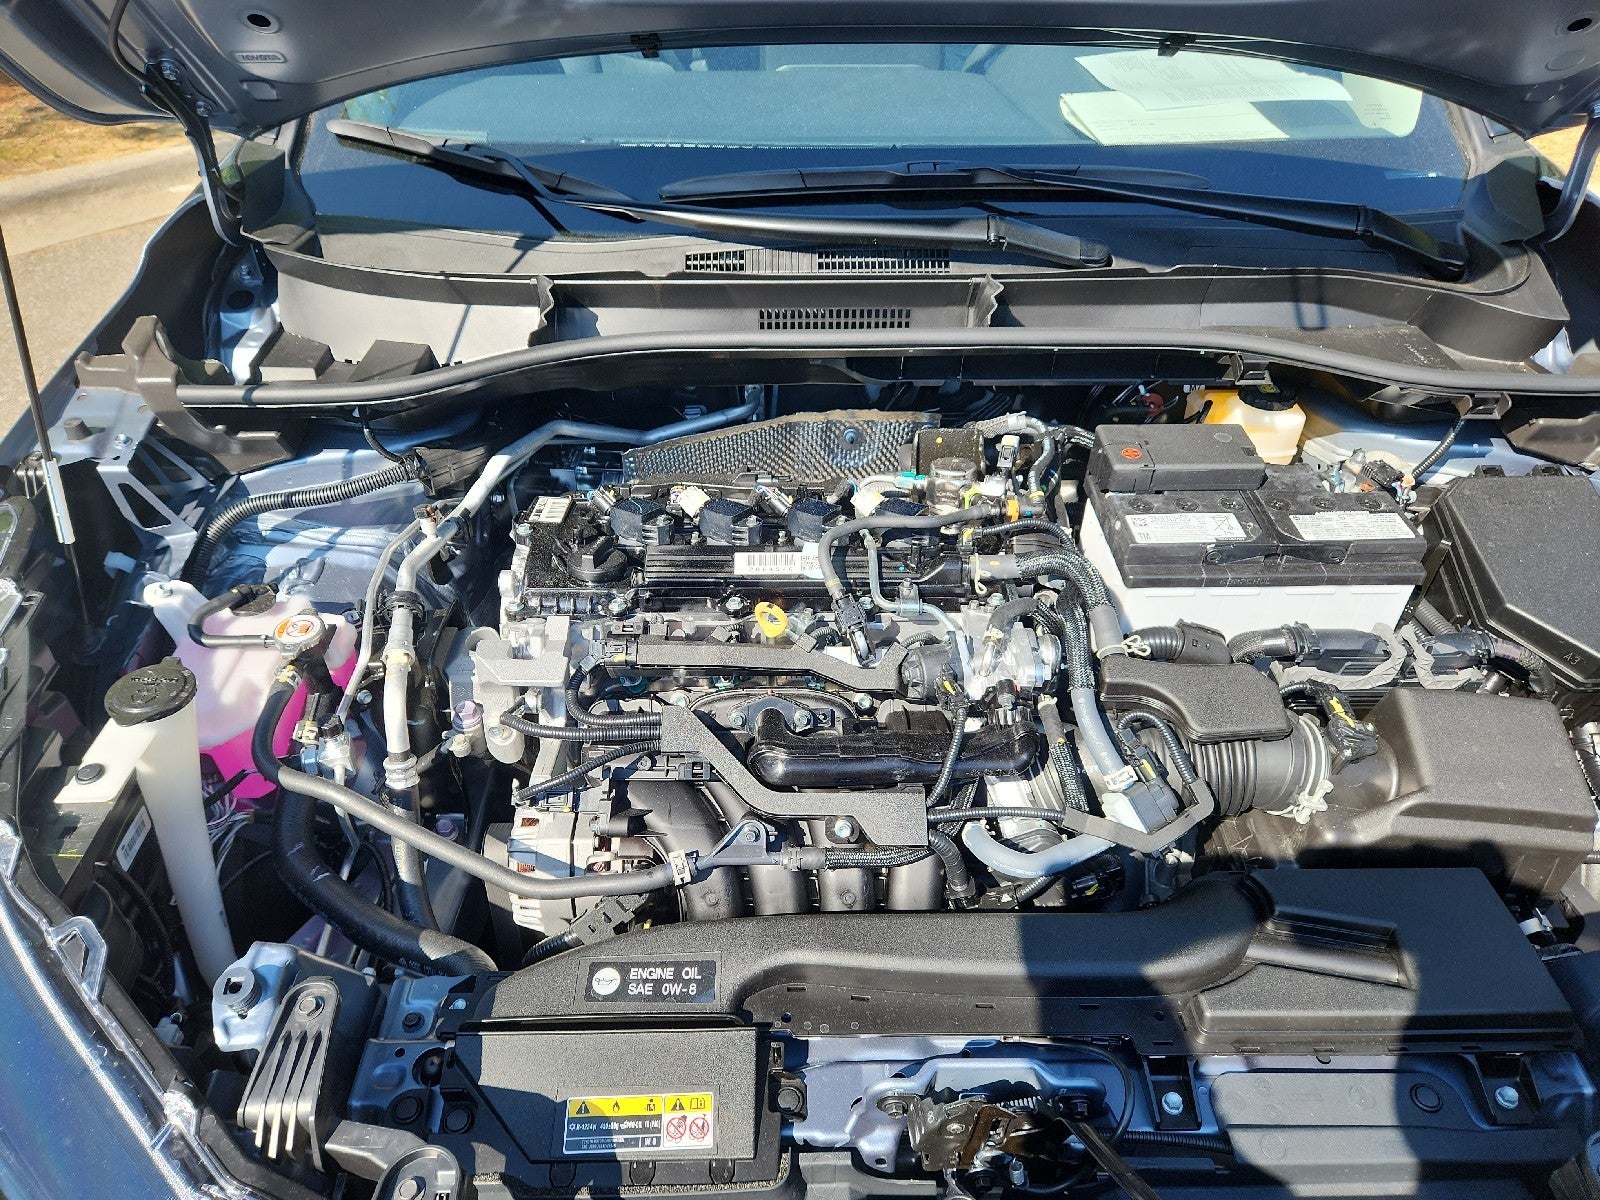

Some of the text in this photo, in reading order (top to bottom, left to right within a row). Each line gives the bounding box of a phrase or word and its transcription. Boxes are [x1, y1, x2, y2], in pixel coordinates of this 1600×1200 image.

[629, 966, 702, 980] ENGINE OIL
[627, 983, 697, 996] SAE 0W-8
